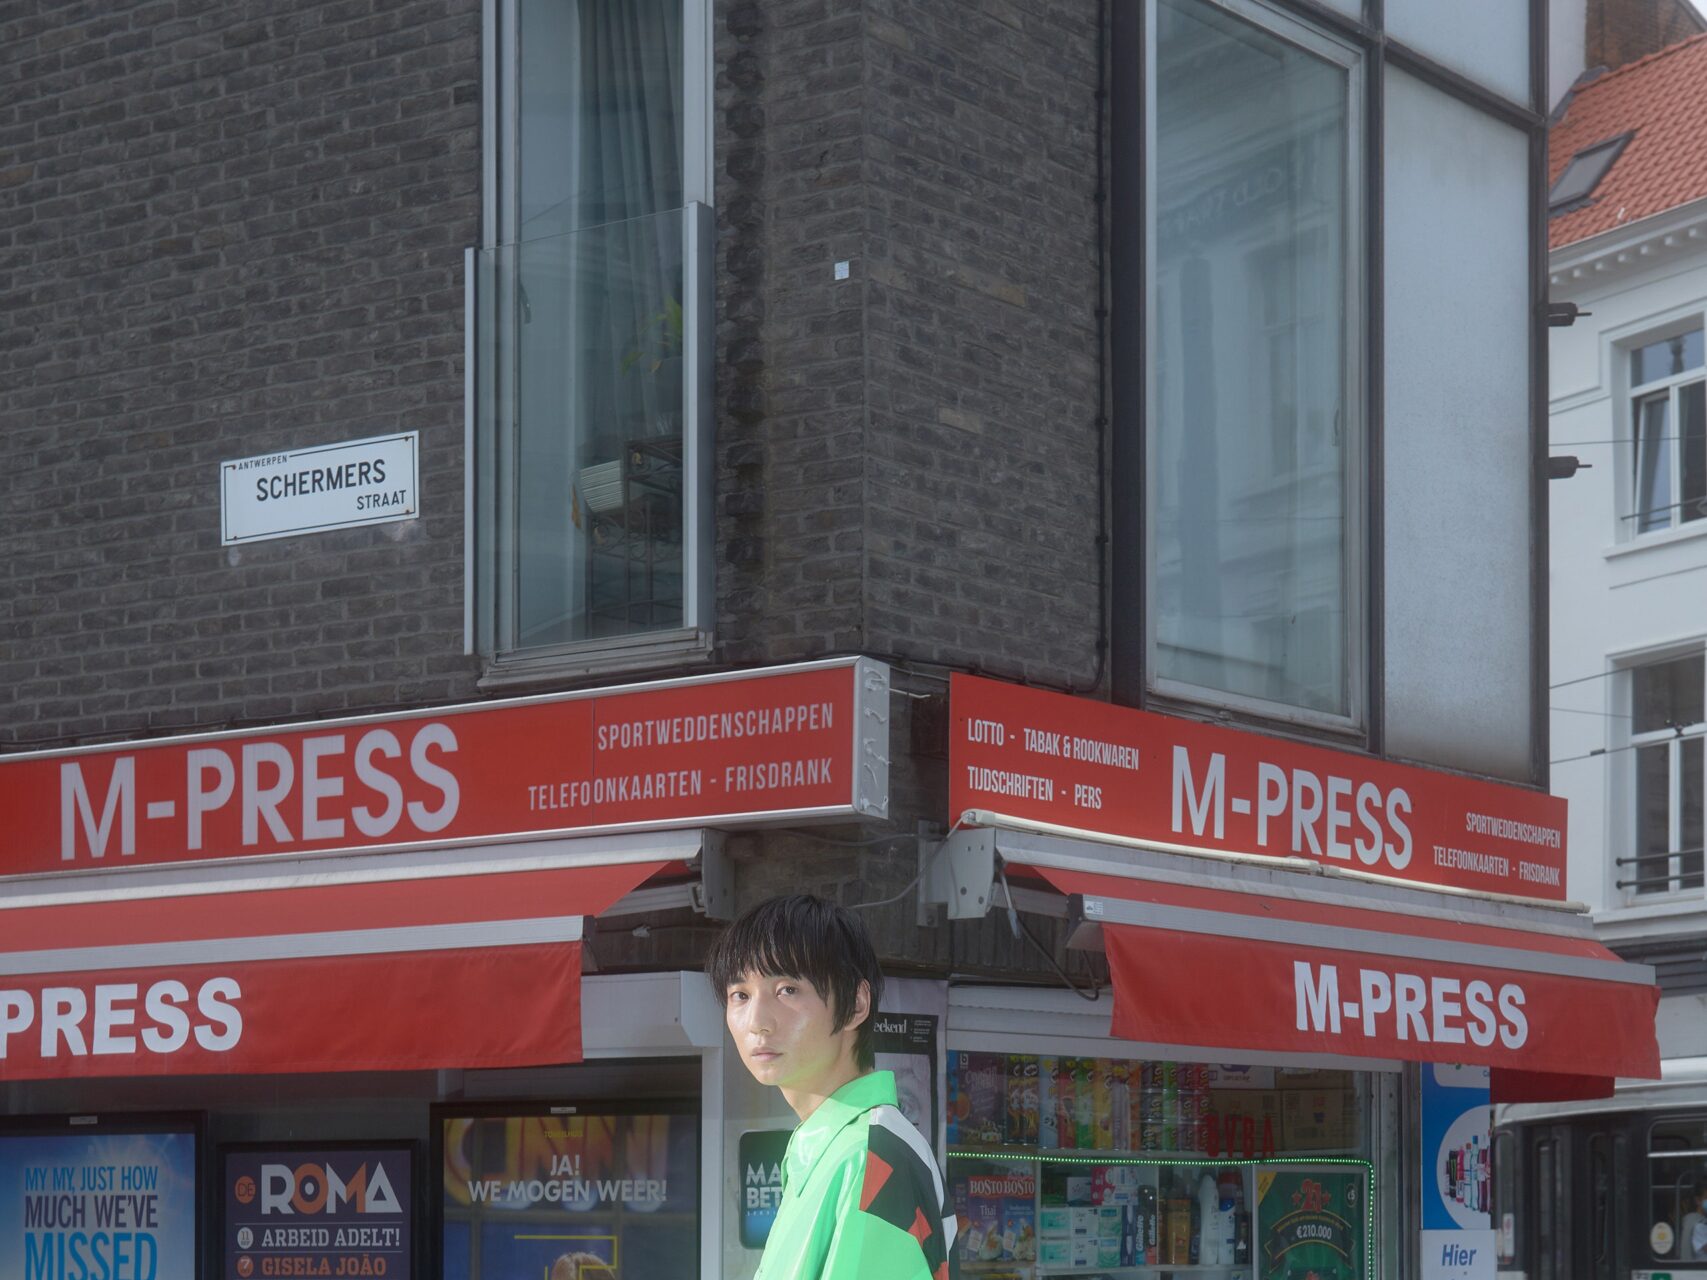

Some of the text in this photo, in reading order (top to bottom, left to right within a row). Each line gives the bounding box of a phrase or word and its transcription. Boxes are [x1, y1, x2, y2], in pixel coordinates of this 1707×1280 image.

[238, 455, 288, 470] ANTWERPEN
[256, 459, 386, 501] SCHERMERS
[356, 490, 406, 510] STRAAT
[597, 702, 833, 751] SPORTWEDDENSCHAPPEN
[967, 718, 1004, 746] LOTTO
[1023, 728, 1060, 756] TABAK
[1063, 736, 1071, 758] &
[1073, 737, 1139, 770] ROOKWAREN
[60, 723, 460, 861] M-PRESS
[528, 769, 701, 811] TELEFOONKAARTEN
[725, 758, 833, 792] FRISDRANK
[967, 766, 1053, 801] TIJDSCHRIFTEN
[1074, 784, 1102, 809] PERS
[1172, 745, 1413, 870] M-PRESS
[1466, 812, 1560, 848] SPORTWEDDENSCHAPPEN
[1433, 845, 1509, 877] TELEFOONKAARTEN
[1520, 861, 1560, 886] FRISDRANK
[1294, 960, 1528, 1049] M-PRESS
[25, 1166, 158, 1195] MY MY, JUST HOW
[551, 1154, 580, 1177] JA!
[238, 1161, 403, 1215] DE ROMA
[467, 1179, 667, 1202] WE MOGEN WEER!
[970, 1180, 1002, 1196] BOSTO
[1004, 1180, 1034, 1196] BOSTO
[1301, 1178, 1322, 1213] 21
[24, 1195, 158, 1228] MUCH WE'VE
[980, 1205, 996, 1216] Thai
[241, 1230, 250, 1240] 11
[261, 1228, 400, 1247] ARBEID ADELT!
[1135, 1214, 1144, 1251] Gillette
[1296, 1224, 1332, 1240] €210.000
[241, 1259, 249, 1270] 7
[262, 1254, 386, 1276] GISELA JOÃO
[1441, 1244, 1477, 1266] Hier
